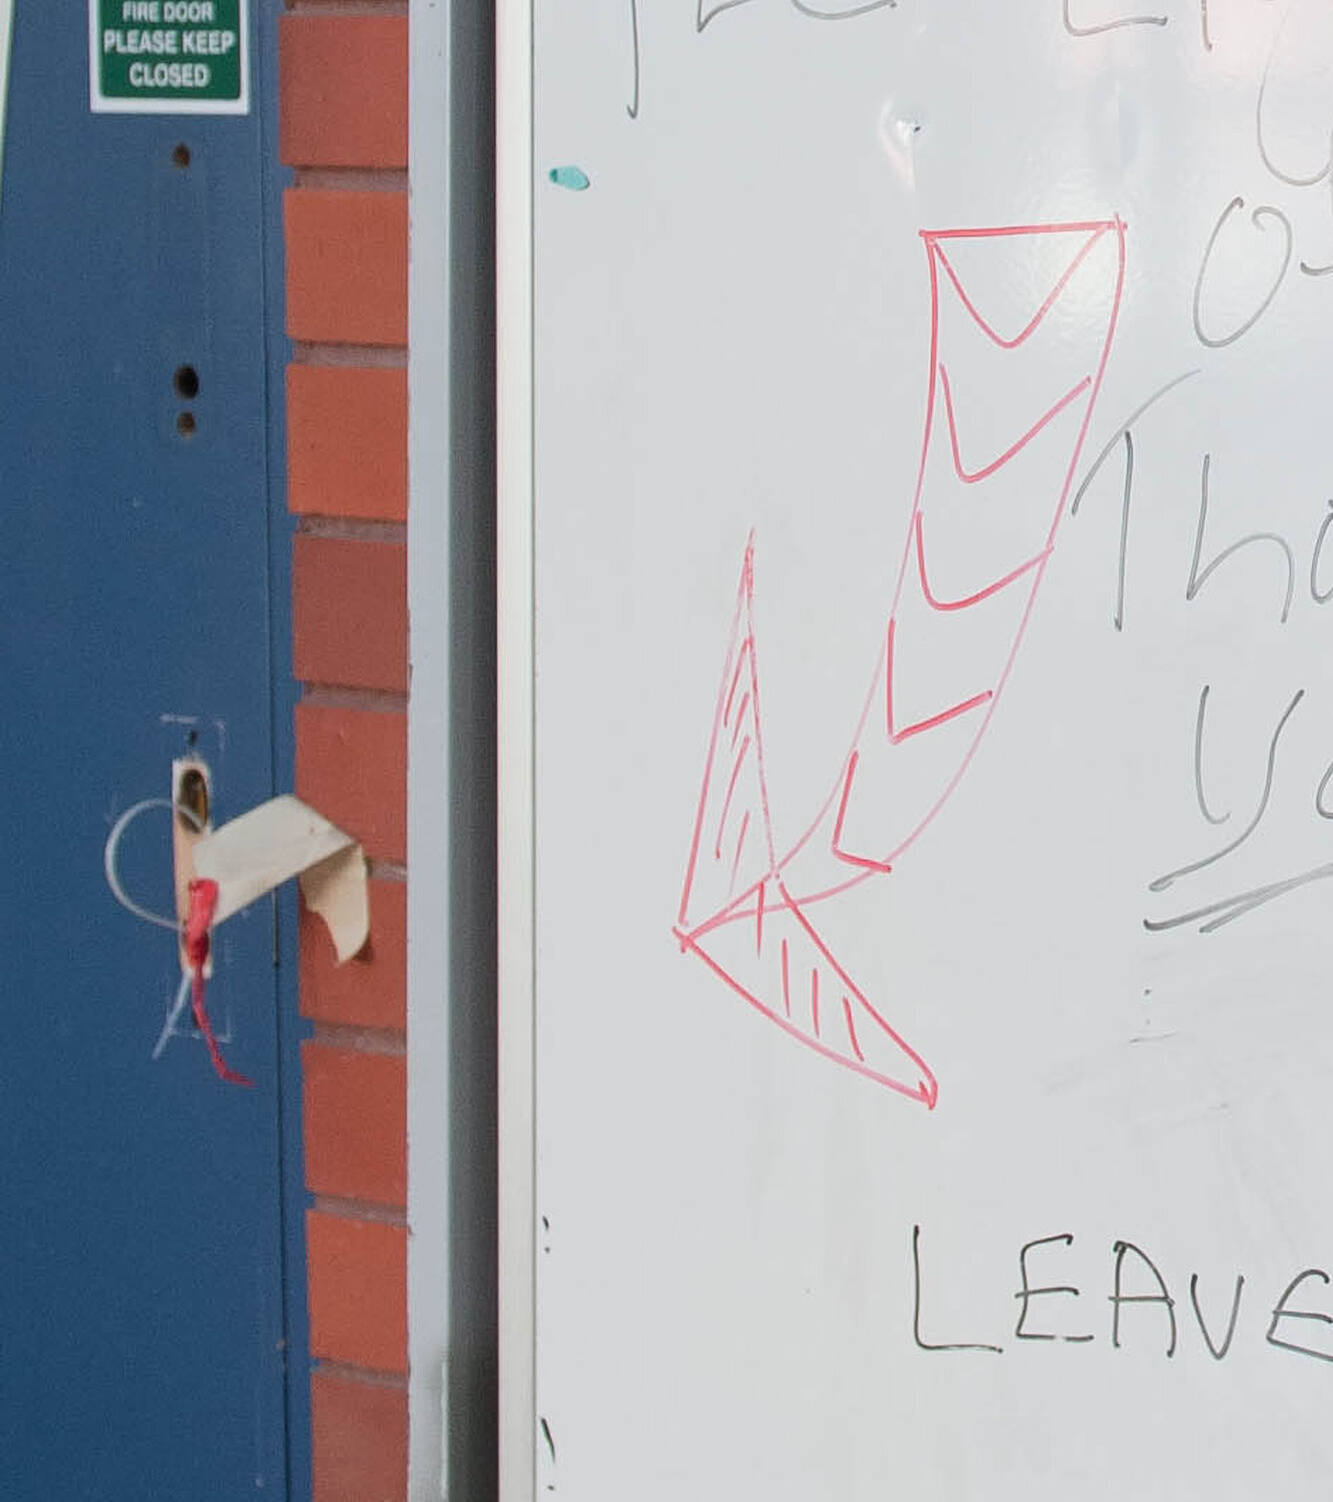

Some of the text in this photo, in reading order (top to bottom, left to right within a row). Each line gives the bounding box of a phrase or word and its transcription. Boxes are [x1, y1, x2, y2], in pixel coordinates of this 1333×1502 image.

[122, 0, 214, 23] FIRE DOOR
[103, 30, 235, 54] PLEASE KEEP
[129, 63, 210, 88] CLOSED
